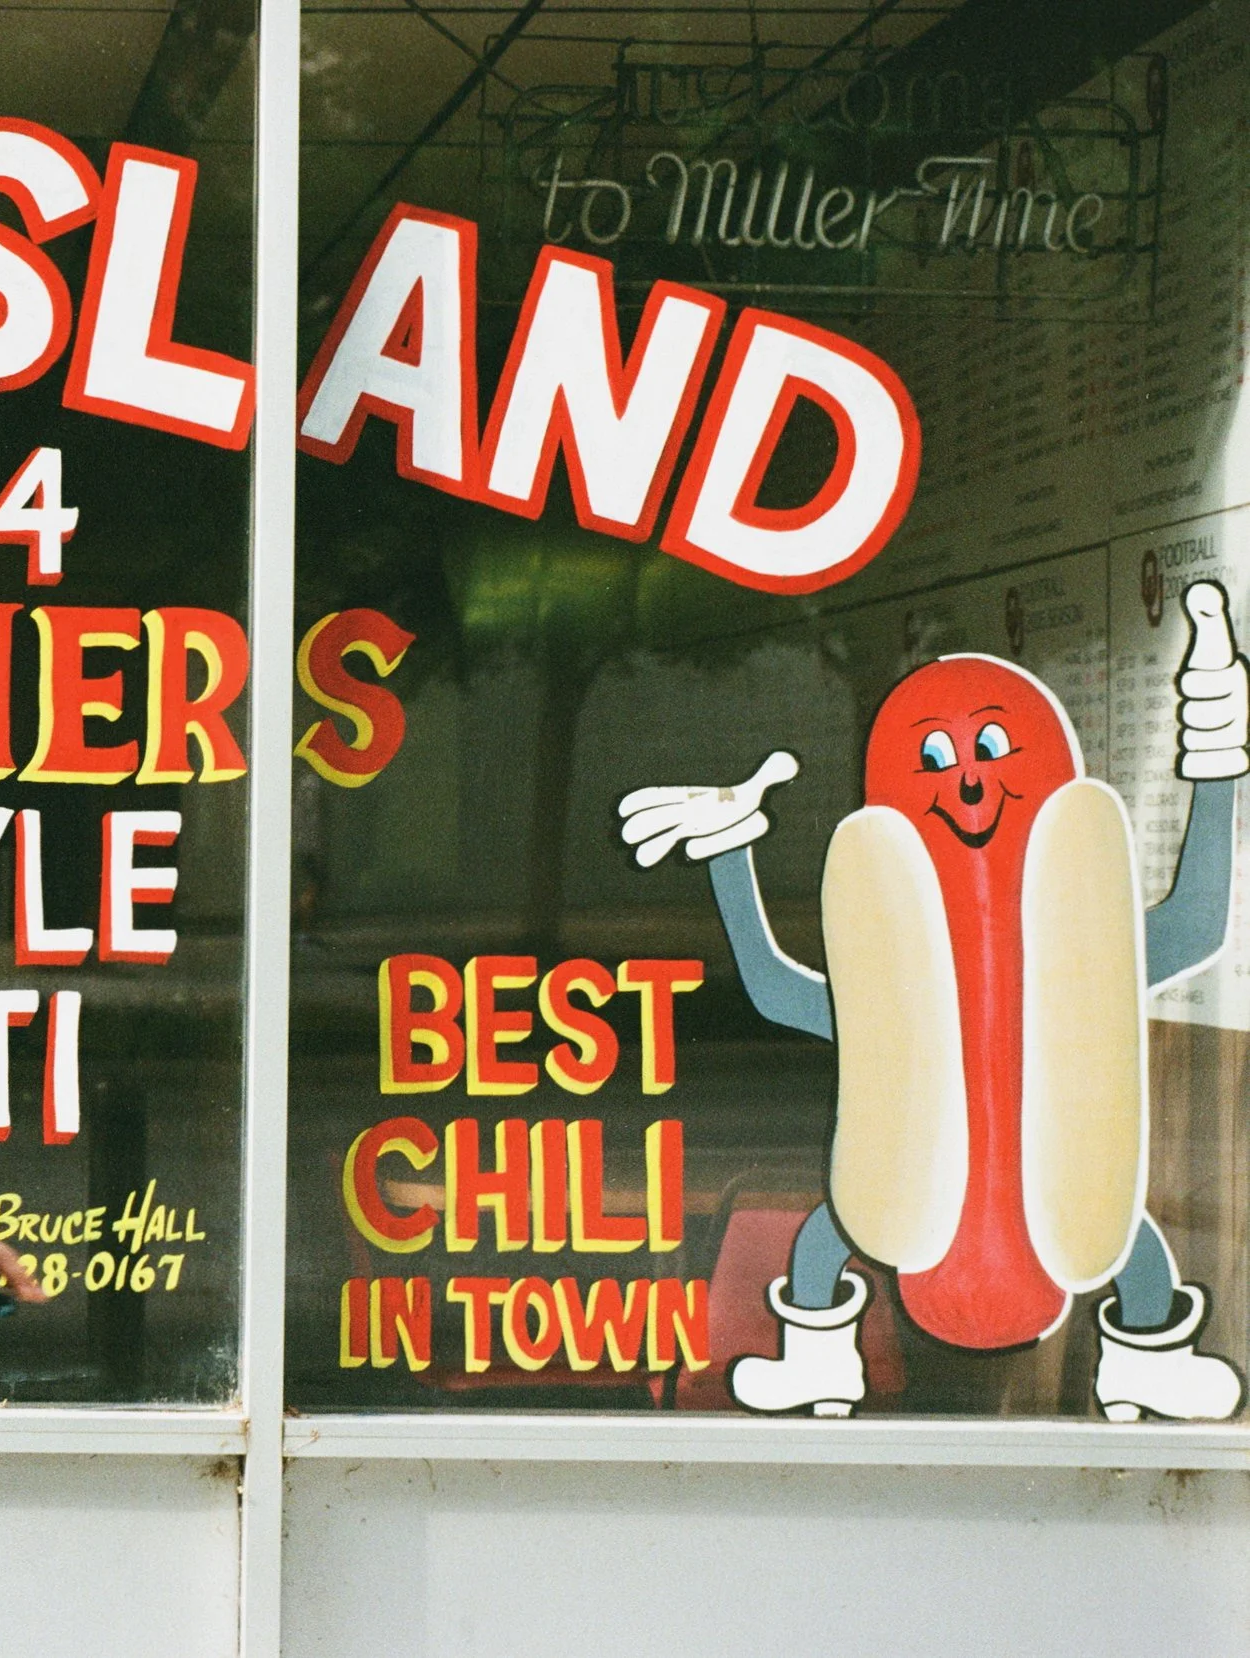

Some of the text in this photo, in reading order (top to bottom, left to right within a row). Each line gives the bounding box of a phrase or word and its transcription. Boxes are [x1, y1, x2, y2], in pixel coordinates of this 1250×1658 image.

[378, 952, 704, 1096] BEST
[342, 1117, 684, 1254] CHILI
[339, 1276, 711, 1373] IN TOWN
